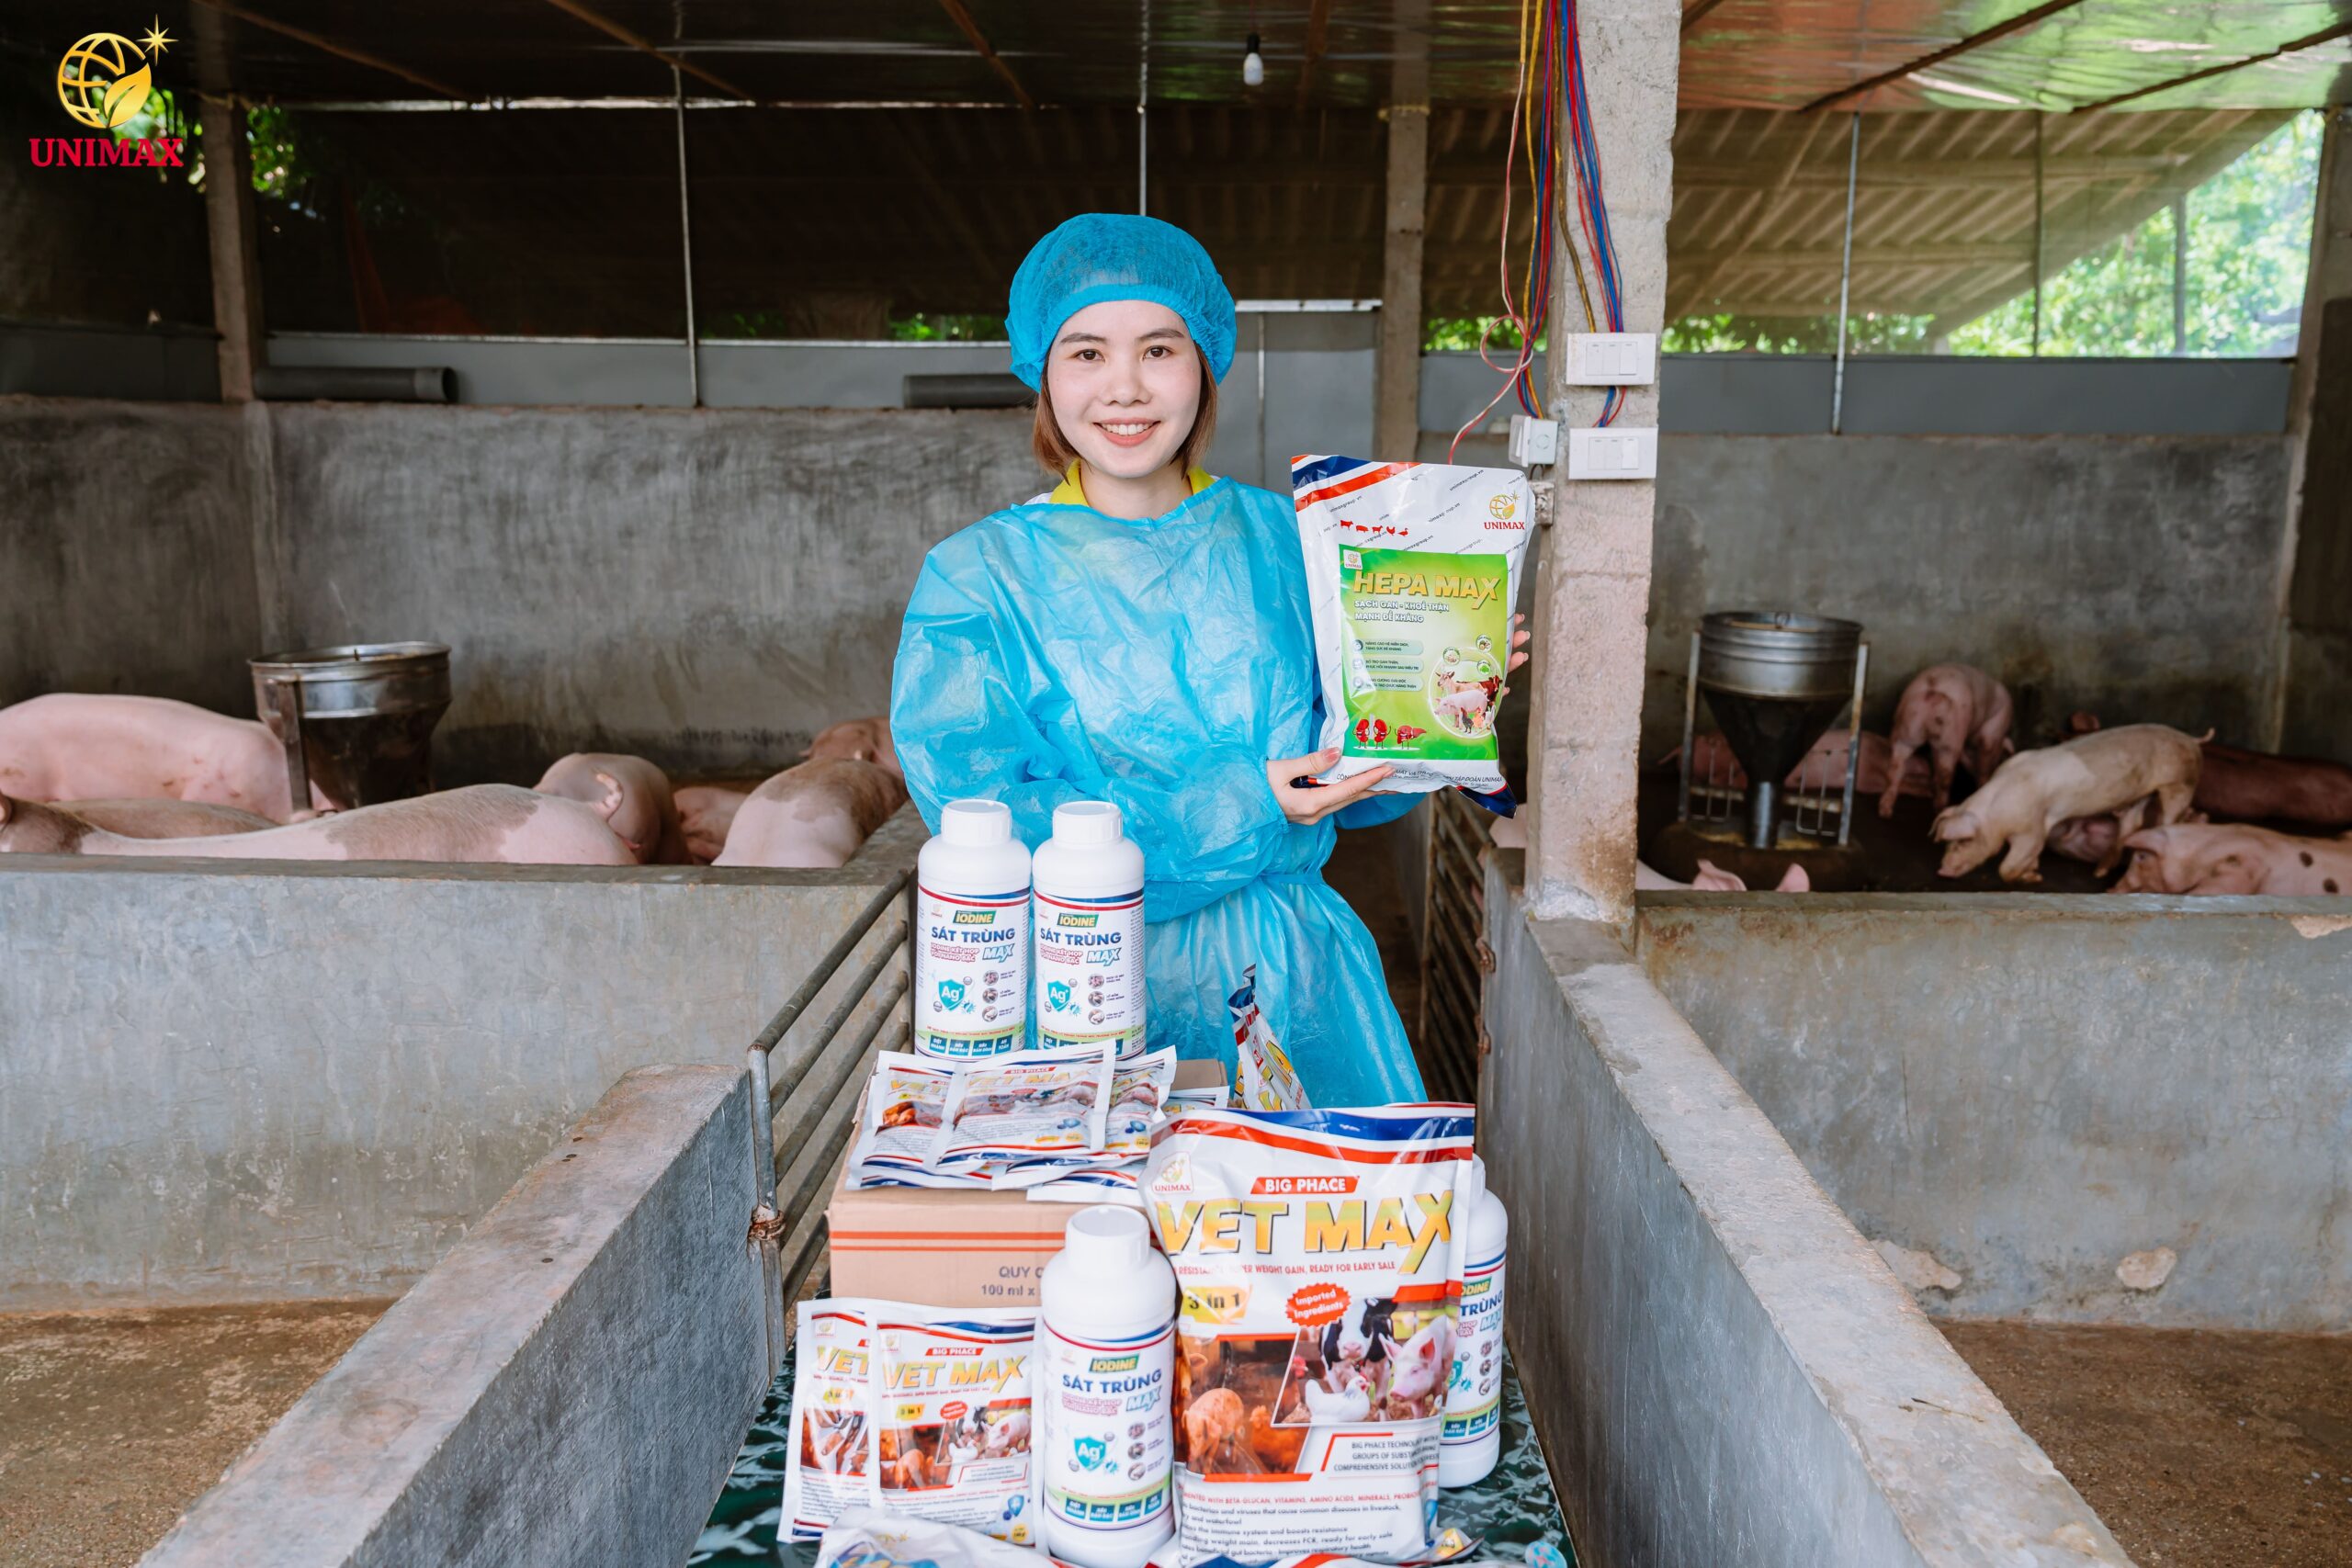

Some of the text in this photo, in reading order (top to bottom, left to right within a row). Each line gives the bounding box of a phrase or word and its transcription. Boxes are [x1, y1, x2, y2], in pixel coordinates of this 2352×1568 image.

[1484, 522, 1525, 530] UNIMAX
[1353, 570, 1500, 610] HEPA MAX
[1354, 600, 1378, 610] SẠCH
[1380, 601, 1399, 609] GAN
[1354, 613, 1380, 622] MẠNH
[1336, 773, 1353, 781] CÔN
[956, 913, 993, 924] IODINE
[1059, 916, 1096, 927] IODINE
[932, 926, 1015, 942] SÁT TRÙNG
[1040, 927, 1122, 946] SÁT TRÙNG
[982, 943, 1015, 963] MAX
[1086, 947, 1122, 966] MAX
[1154, 1184, 1192, 1192] UNIMAX
[1265, 1178, 1346, 1192] BIG PHACE
[1154, 1189, 1454, 1274] VET MAX
[999, 1266, 1031, 1279] QUY
[1256, 1264, 1283, 1274] WEIGHT
[1309, 1264, 1333, 1273] READY
[1336, 1263, 1351, 1272] FOR
[1353, 1261, 1376, 1271] EARLY
[1378, 1260, 1396, 1269] SALE
[981, 1284, 1035, 1296] 100 ml x
[1206, 1293, 1225, 1309] in
[1231, 1292, 1240, 1307] 1
[1295, 1289, 1337, 1306] Imported
[1460, 1290, 1503, 1316] TRÙNG
[1294, 1301, 1344, 1319] Ingredients
[817, 1345, 869, 1376] VET
[1091, 1358, 1137, 1372] IODINE
[882, 1360, 946, 1389] VET
[949, 1355, 1027, 1394] MAX
[1062, 1369, 1162, 1393] SÁT TRÙNG
[1364, 1440, 1385, 1449] PHACE
[1352, 1451, 1379, 1460] GROUPS
[1333, 1461, 1388, 1472] COMPREHENSIVE
